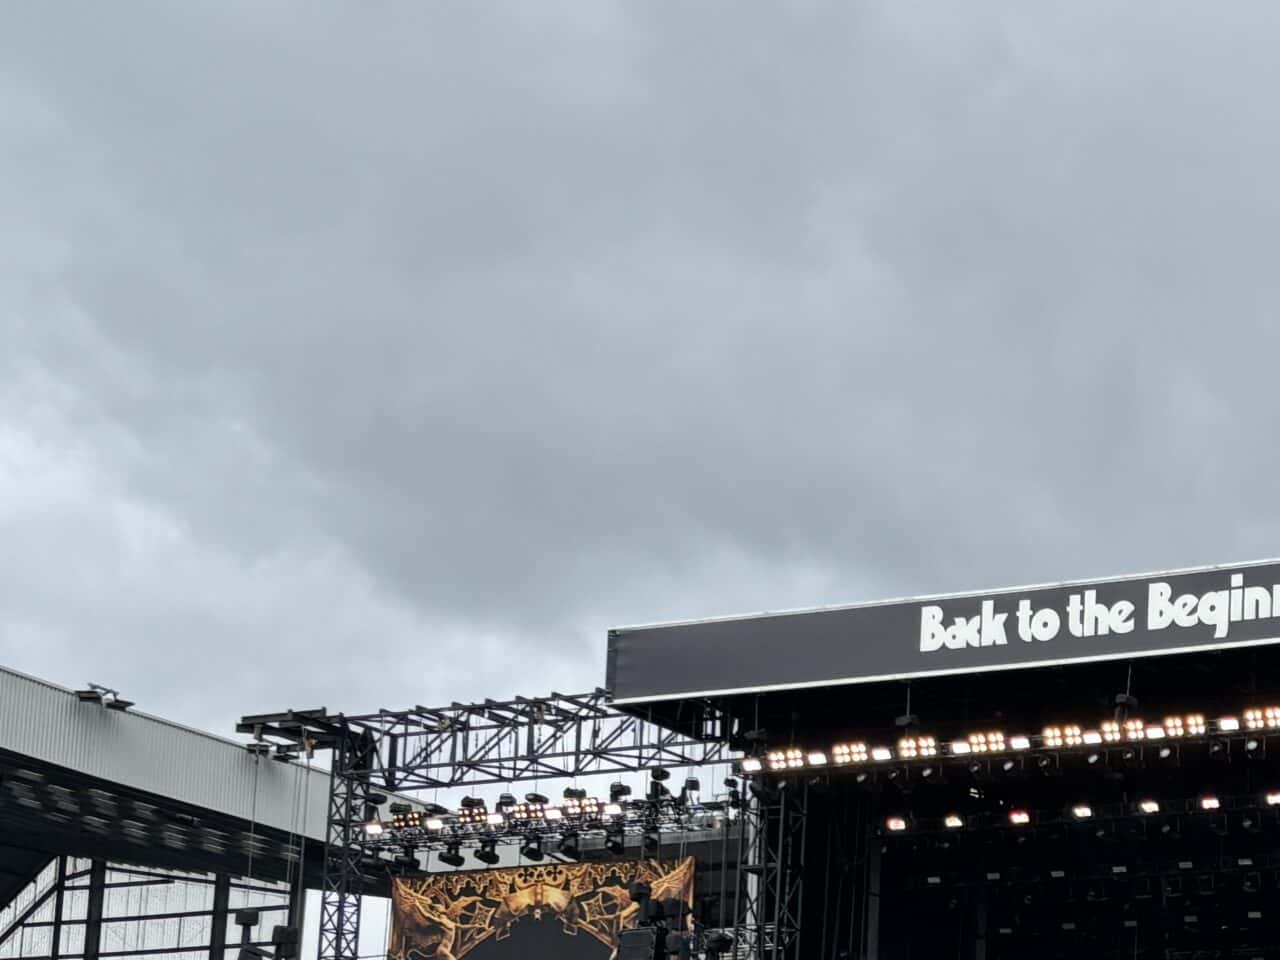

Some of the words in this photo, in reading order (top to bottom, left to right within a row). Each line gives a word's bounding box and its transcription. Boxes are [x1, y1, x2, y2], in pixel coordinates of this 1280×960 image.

[919, 599, 1008, 652] Back
[1016, 599, 1061, 642] to
[1066, 589, 1135, 637] the
